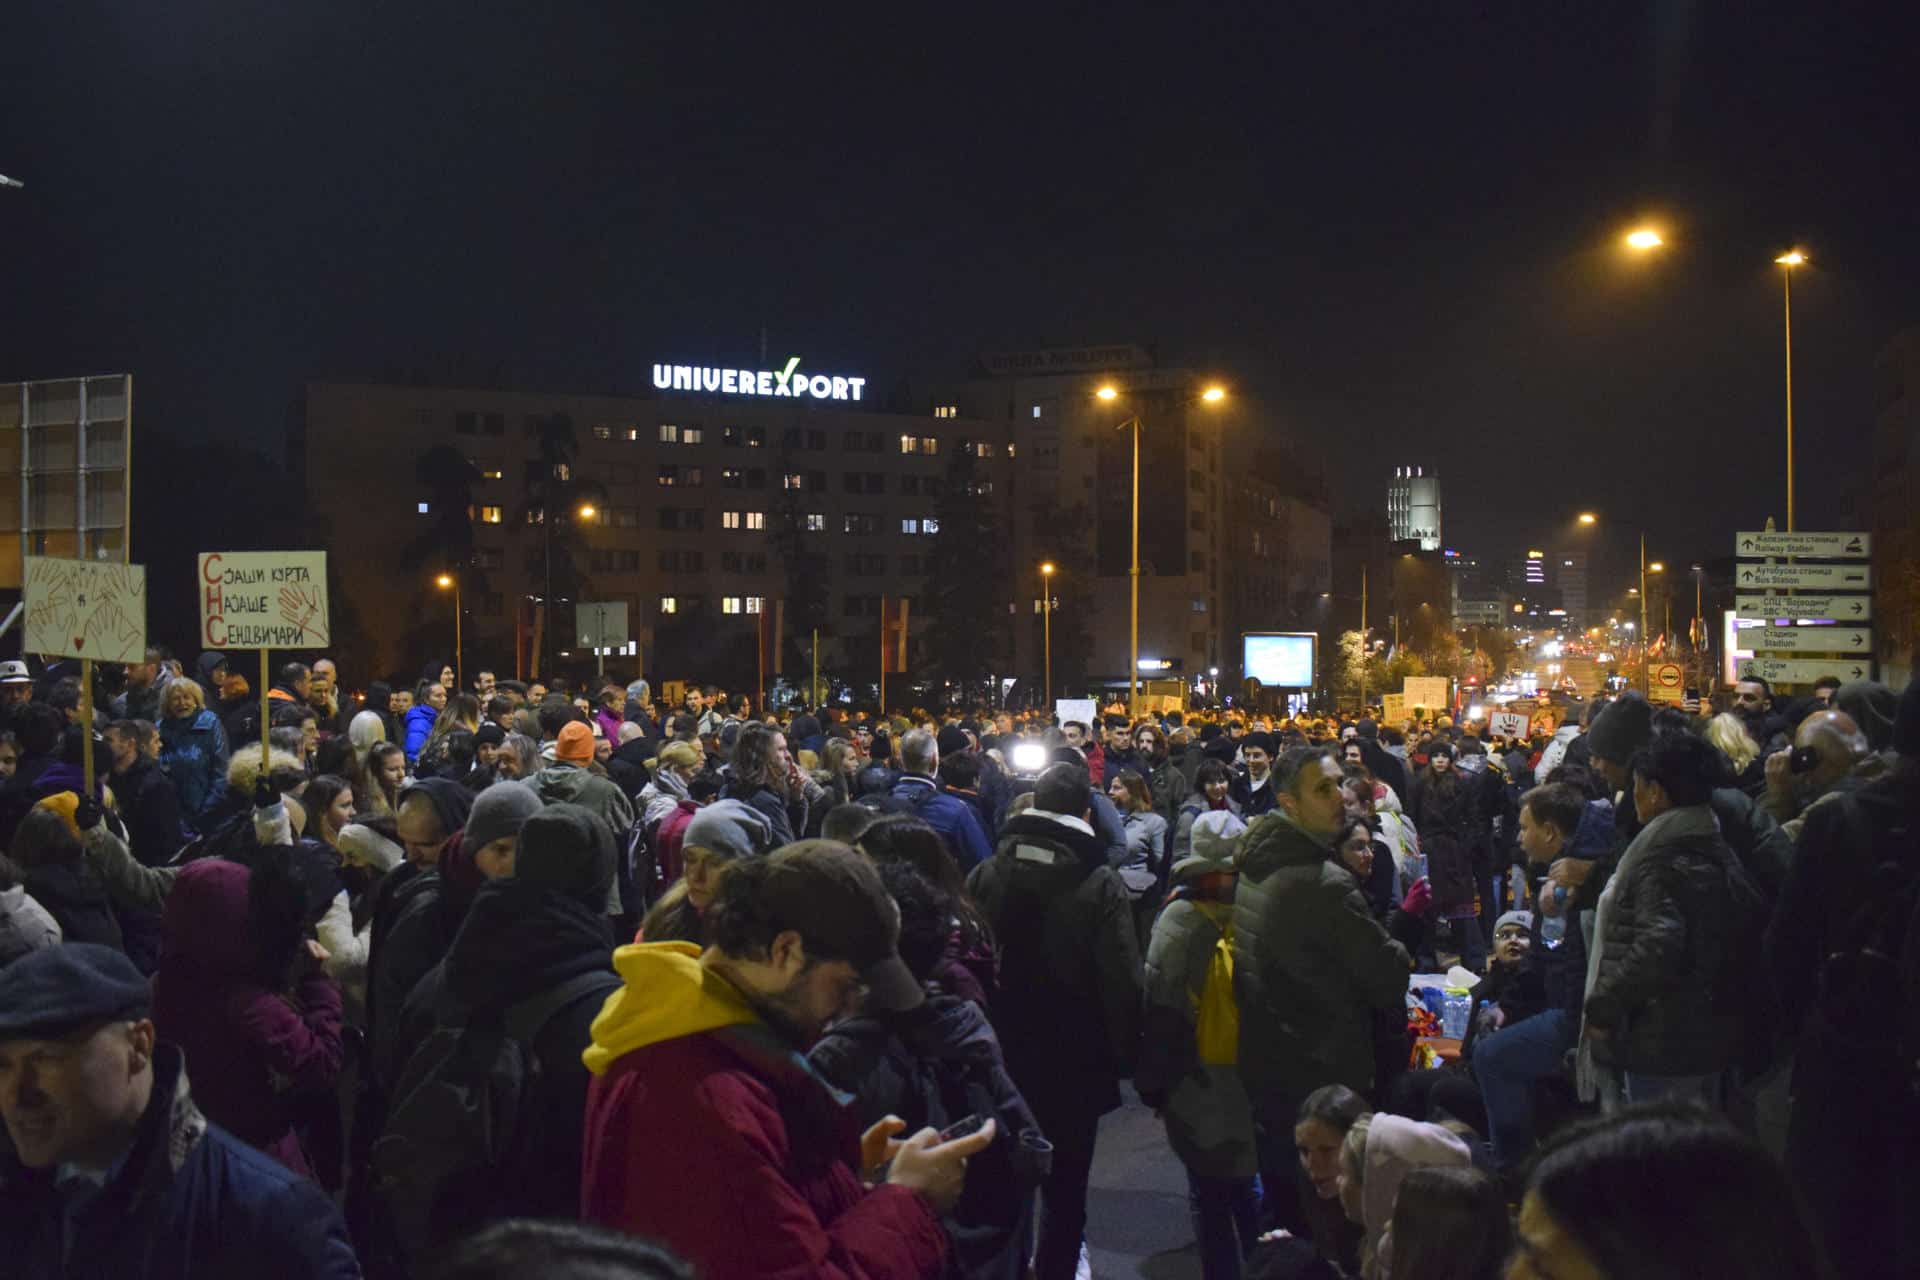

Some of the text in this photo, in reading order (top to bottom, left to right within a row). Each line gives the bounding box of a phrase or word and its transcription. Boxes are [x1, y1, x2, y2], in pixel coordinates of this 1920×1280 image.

[653, 357, 866, 401] UNIVEREXPORT
[1755, 544, 1815, 554] Railway Station
[271, 567, 310, 582] КУРТА
[1755, 576, 1800, 585] Bus Station
[1764, 629, 1798, 638] Стадион
[1764, 639, 1796, 648] Stadium
[1763, 670, 1777, 679] Fair
